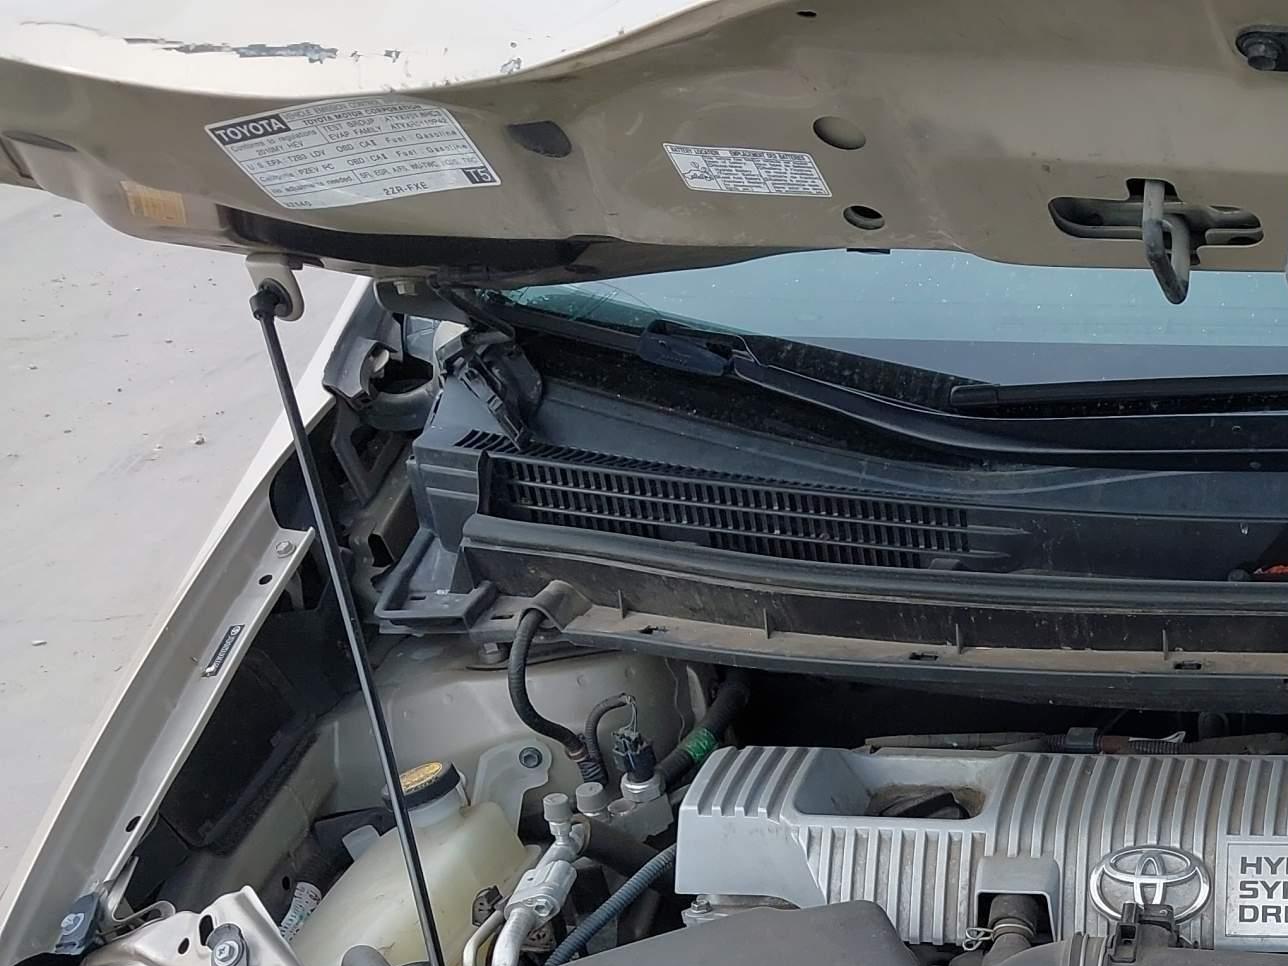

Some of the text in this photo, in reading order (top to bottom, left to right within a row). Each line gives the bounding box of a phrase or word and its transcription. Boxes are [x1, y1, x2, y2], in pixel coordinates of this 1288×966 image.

[303, 105, 422, 126] TOYOTA MOTOR CORPORATION
[324, 121, 344, 132] TEST
[346, 118, 375, 129] GROUP
[215, 117, 287, 142] TOYOTA
[329, 130, 350, 141] EVAP
[354, 125, 382, 137] FAMILY
[287, 141, 304, 150] HEV
[310, 149, 327, 159] LDV
[336, 143, 354, 153] OBD
[386, 134, 406, 144] Fuel
[415, 130, 458, 141] Gasoline
[298, 166, 320, 176] PZEV
[322, 163, 336, 171] PC
[347, 156, 365, 167] OBD
[397, 148, 417, 158] Fuel
[425, 143, 469, 154] Gasoline
[383, 181, 429, 195] 2ZR-FXE
[466, 169, 492, 184] T5
